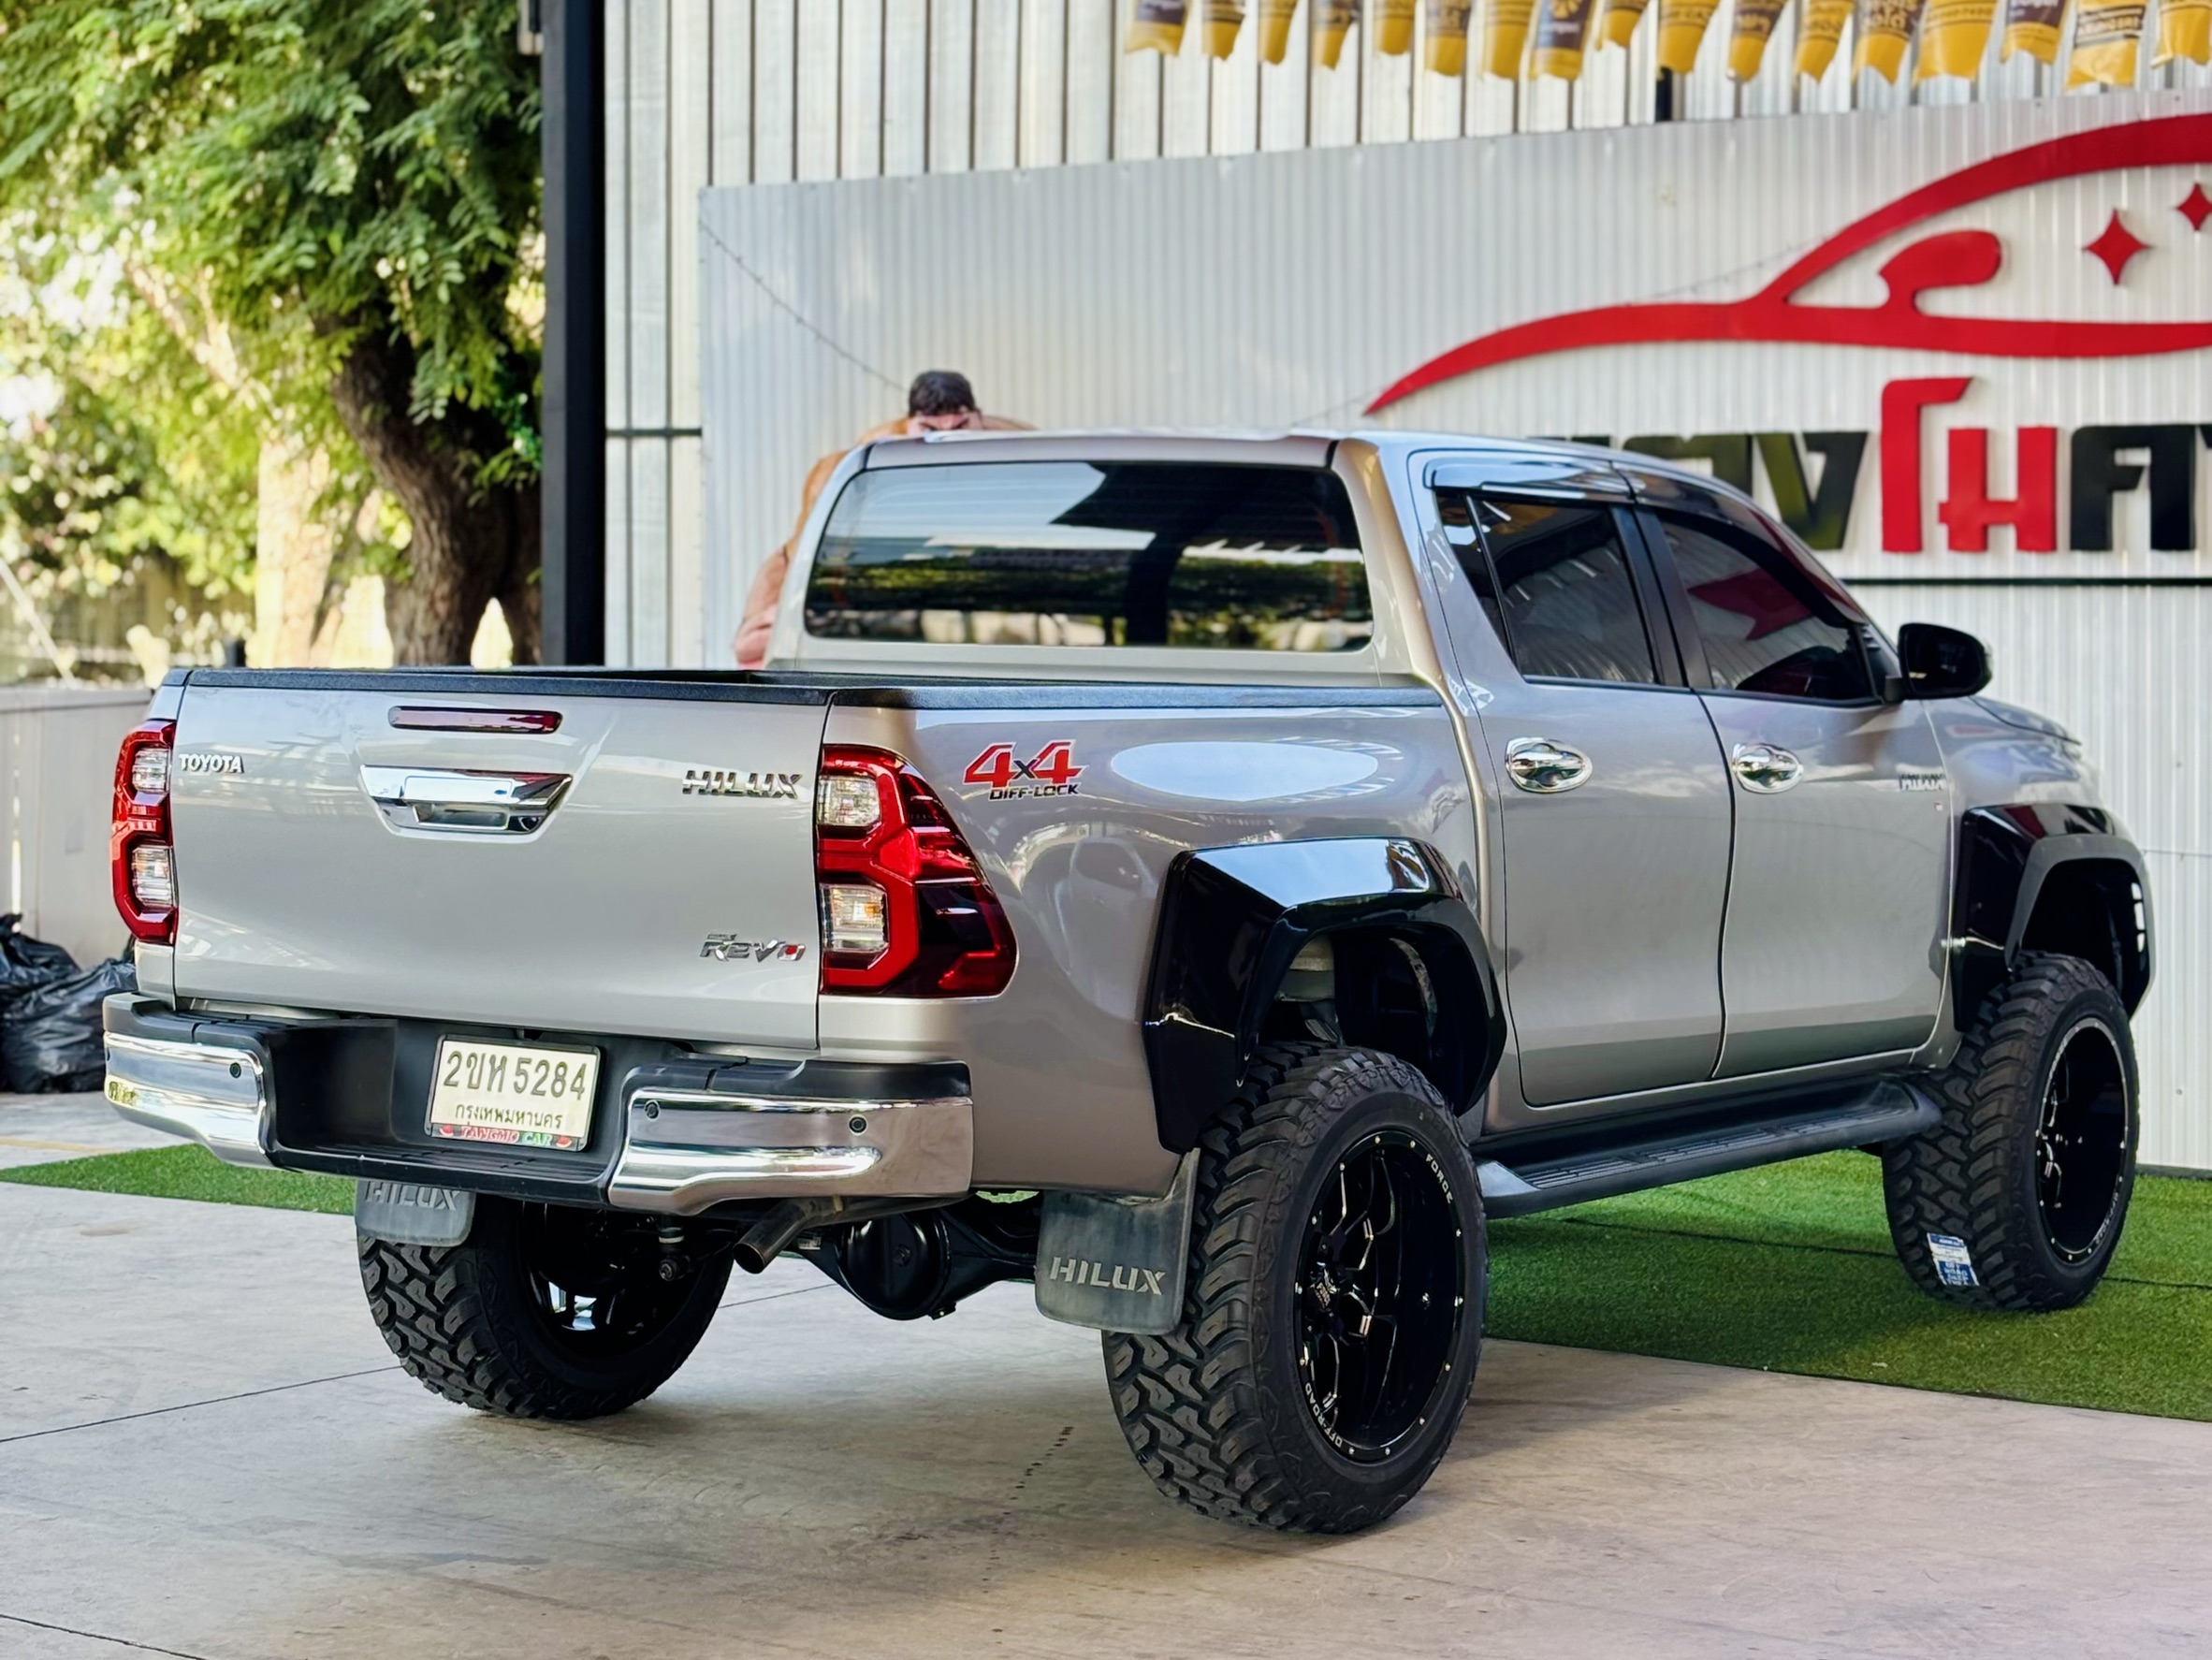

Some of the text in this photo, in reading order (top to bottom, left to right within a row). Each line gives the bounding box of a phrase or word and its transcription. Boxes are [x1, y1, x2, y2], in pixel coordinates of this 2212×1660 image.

[179, 753, 245, 774] TOYOTA
[963, 739, 1090, 789] 4x4
[682, 769, 803, 800] HILUX
[989, 783, 1080, 801] DIFF-LOCK
[514, 1056, 588, 1101] 5284
[455, 1104, 563, 1129] กรุงเทพมหานคร
[459, 1126, 554, 1147] TANGMO CAR
[365, 1180, 460, 1211] HILUX
[1049, 1256, 1166, 1296] HILUX
[1305, 1382, 1343, 1449] OFF-ROAD
